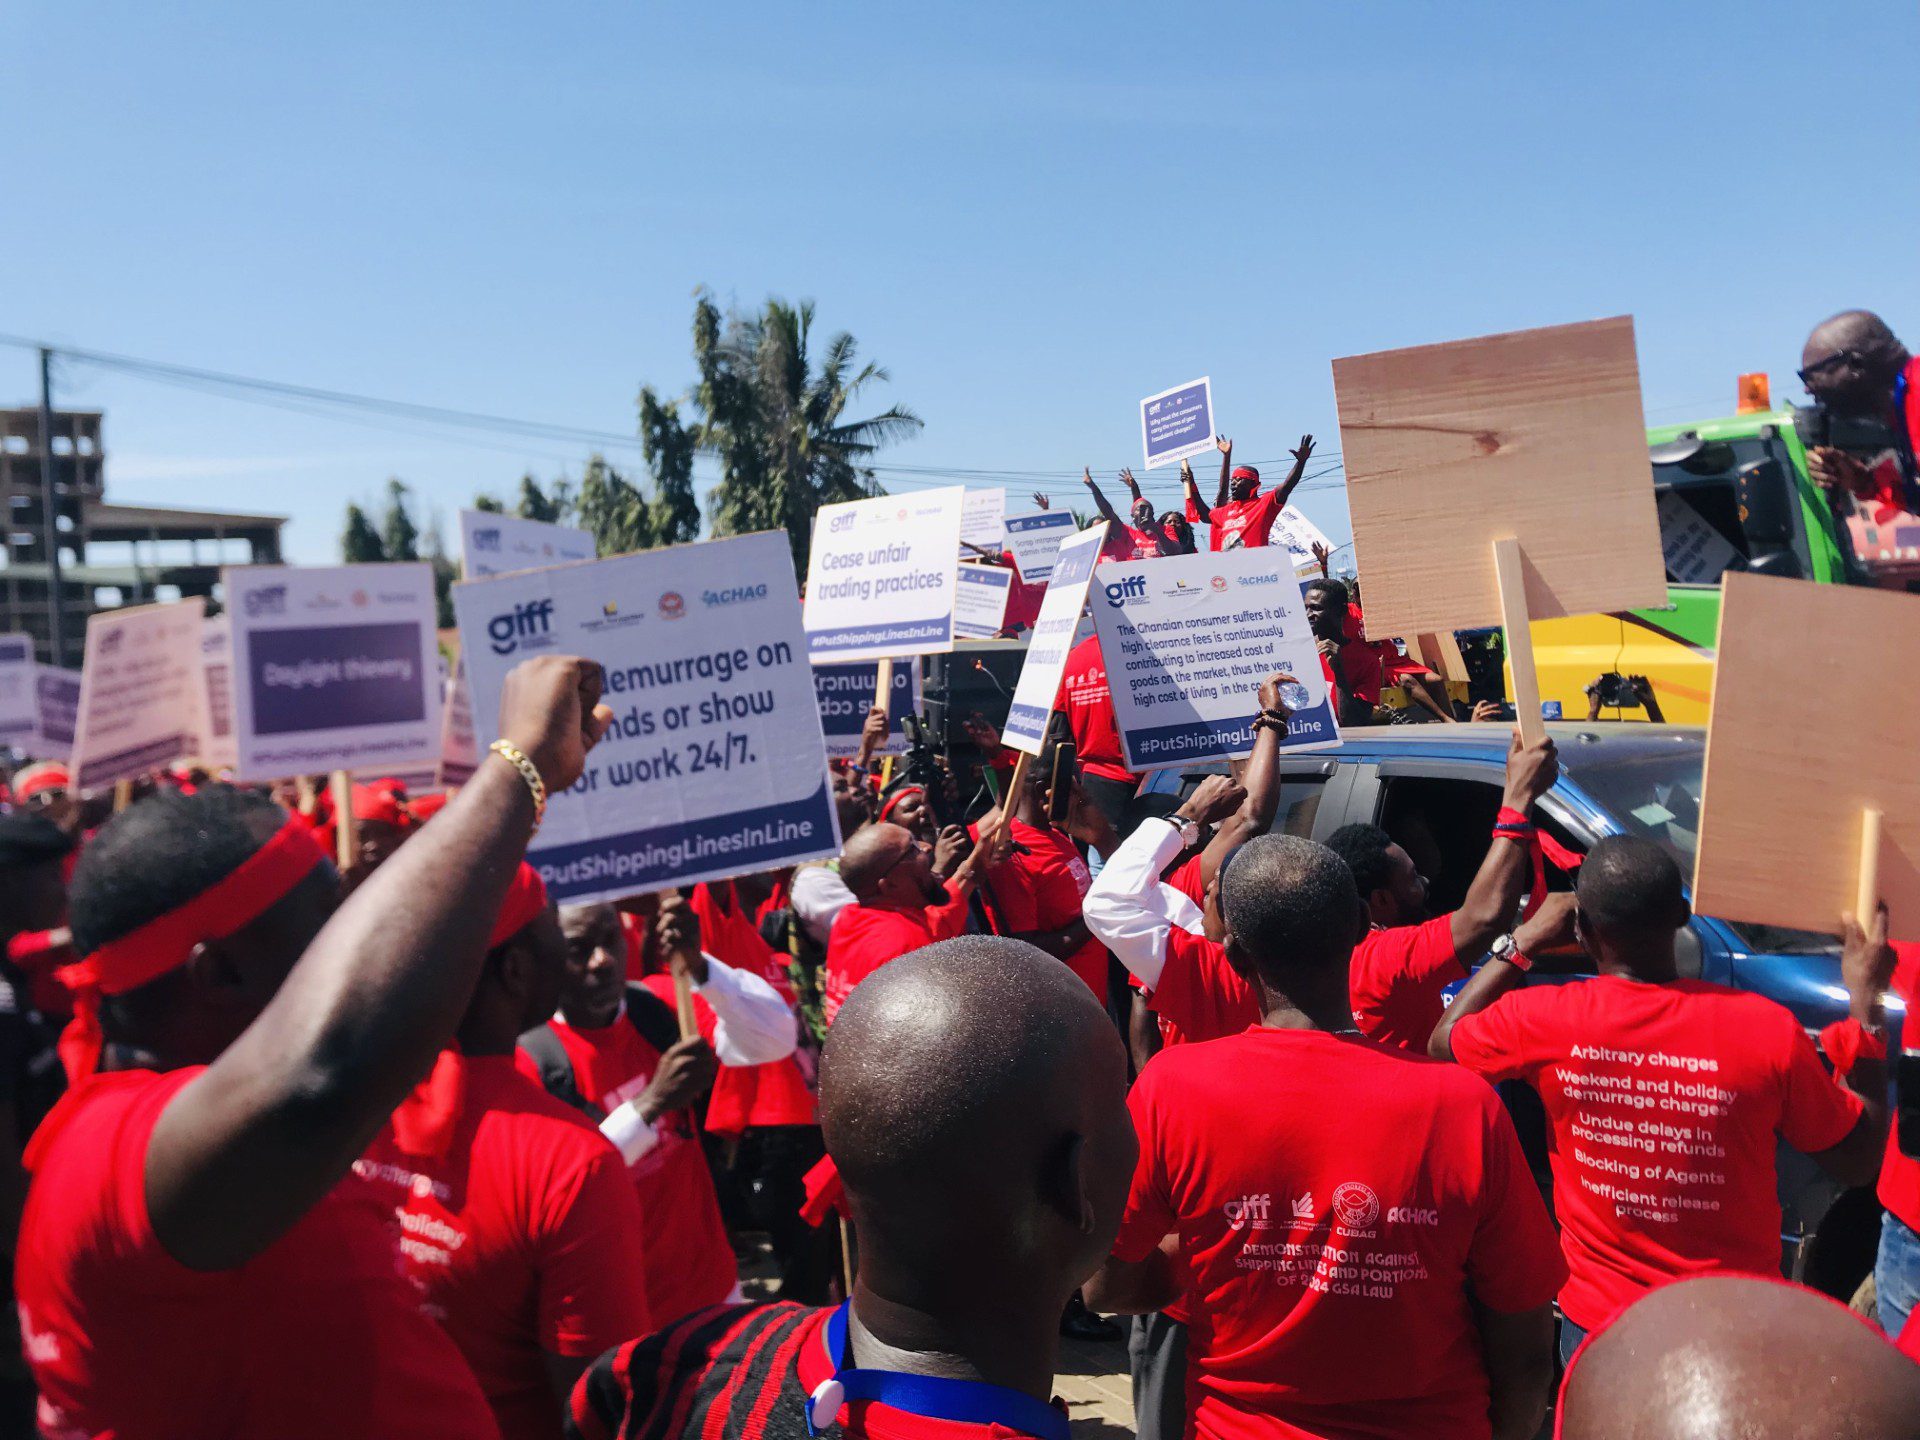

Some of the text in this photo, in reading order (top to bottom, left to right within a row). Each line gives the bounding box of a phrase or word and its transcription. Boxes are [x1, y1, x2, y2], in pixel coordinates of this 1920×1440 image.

[830, 510, 857, 533] giff
[822, 541, 911, 571] Cease unfair
[708, 583, 768, 606] ACHAG
[819, 577, 870, 601] trading
[875, 569, 943, 598] practices
[1105, 575, 1147, 608] giff
[1240, 573, 1278, 586] ACHAG
[488, 598, 555, 655] giff
[812, 625, 944, 647] #PutShippingLinesInLine
[1117, 624, 1136, 637] The
[1137, 618, 1184, 635] Ghanaian
[1185, 614, 1231, 629] consumer
[1232, 610, 1264, 626] suffers
[1265, 608, 1273, 620] it
[1273, 605, 1287, 619] all
[756, 640, 793, 668] on
[1121, 624, 1284, 656] high clearance fees is continuously
[1125, 643, 1274, 671] contributing to increased cost of
[263, 658, 341, 690] Daylight
[1129, 658, 1293, 691] goods on the market, thus the very
[663, 708, 690, 731] or
[699, 688, 775, 724] show
[1133, 693, 1156, 708] high
[1157, 690, 1178, 703] cost
[1180, 687, 1190, 700] of
[1190, 685, 1218, 700] living
[1221, 682, 1231, 696] in
[1231, 680, 1249, 694] the
[1139, 718, 1322, 755] #PutShippingLinLine
[564, 730, 756, 796] or work 24/7.
[540, 818, 814, 886] PutShippingLinesInLine
[1570, 1044, 1719, 1073] Arbitrary charges
[1555, 1067, 1738, 1105] Weekend and holiday
[1563, 1086, 1728, 1118] demurrage charges
[1571, 1124, 1726, 1158] processing refunds
[1579, 1111, 1712, 1142] Undue delays in
[1574, 1147, 1726, 1186] Blocking of Agents
[1580, 1174, 1721, 1212] Inefficient release
[1223, 1193, 1272, 1231] giff
[1386, 1206, 1439, 1227] ACHAG
[1615, 1203, 1679, 1224] process
[1336, 1226, 1377, 1239] CUBAG
[1242, 1242, 1420, 1267] DEMONSTRATION AGAINST
[1234, 1258, 1429, 1285] SHIPPING LINES AND PORTIONS
[1276, 1275, 1297, 1287] OF
[1331, 1283, 1360, 1296] GSA
[1362, 1285, 1394, 1300] LAW
